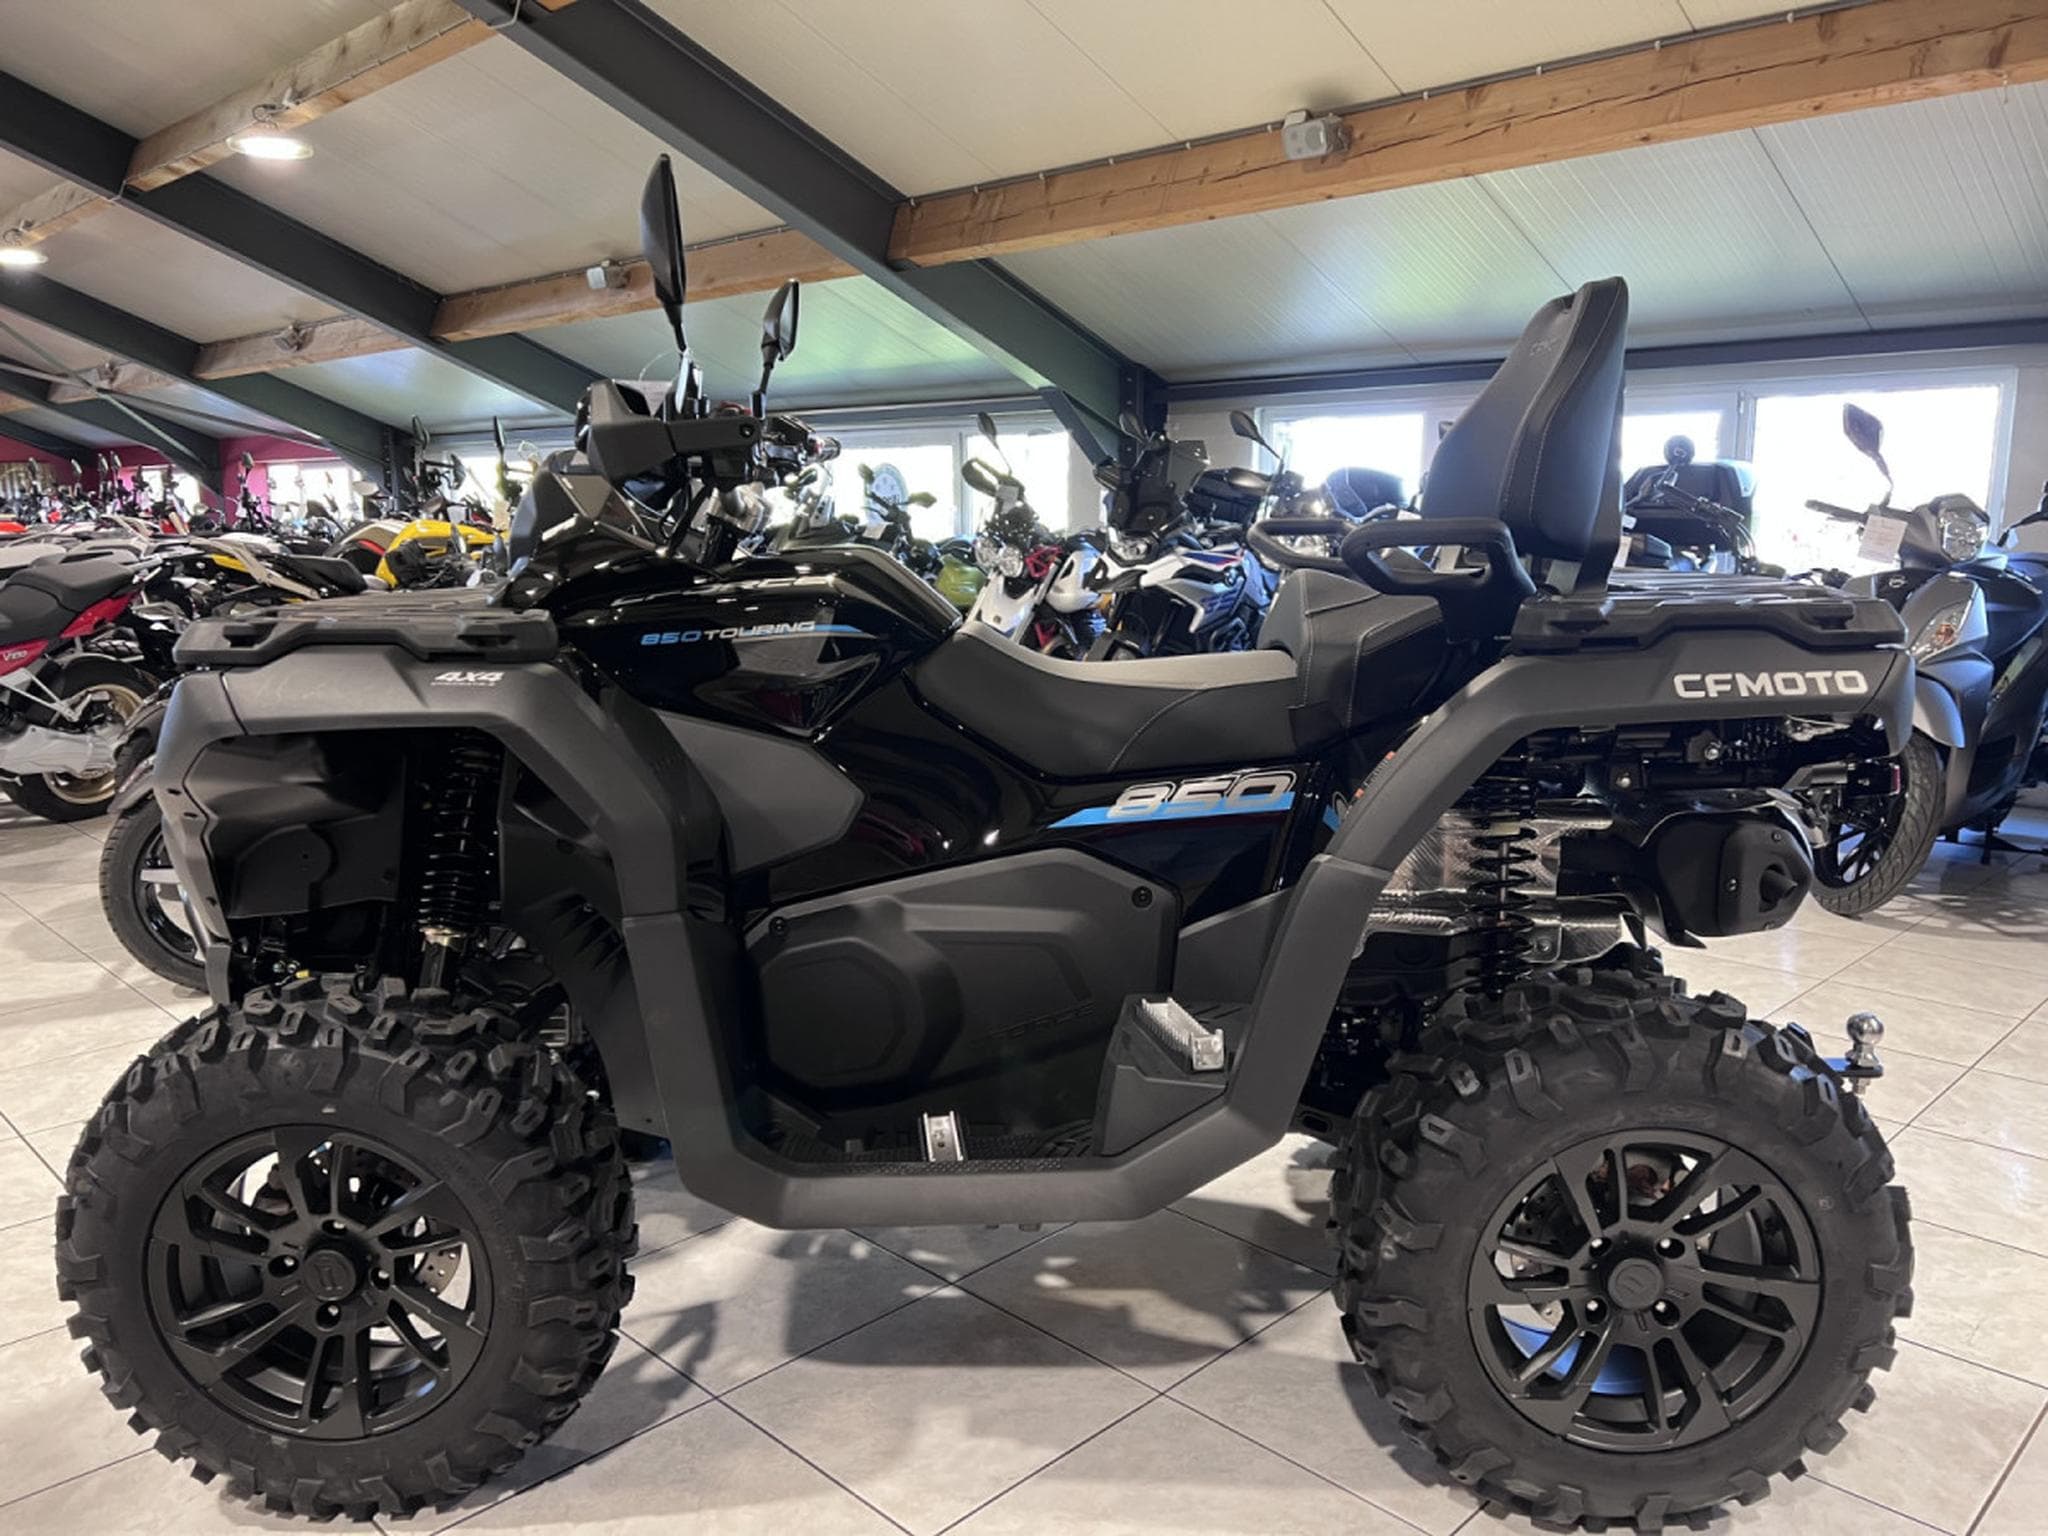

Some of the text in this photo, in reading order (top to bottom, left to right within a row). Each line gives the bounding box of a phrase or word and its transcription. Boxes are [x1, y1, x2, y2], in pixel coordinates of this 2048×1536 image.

[640, 620, 817, 646] 850 TOURING
[1673, 670, 1869, 699] CFMOTO
[1106, 766, 1297, 819] 850
